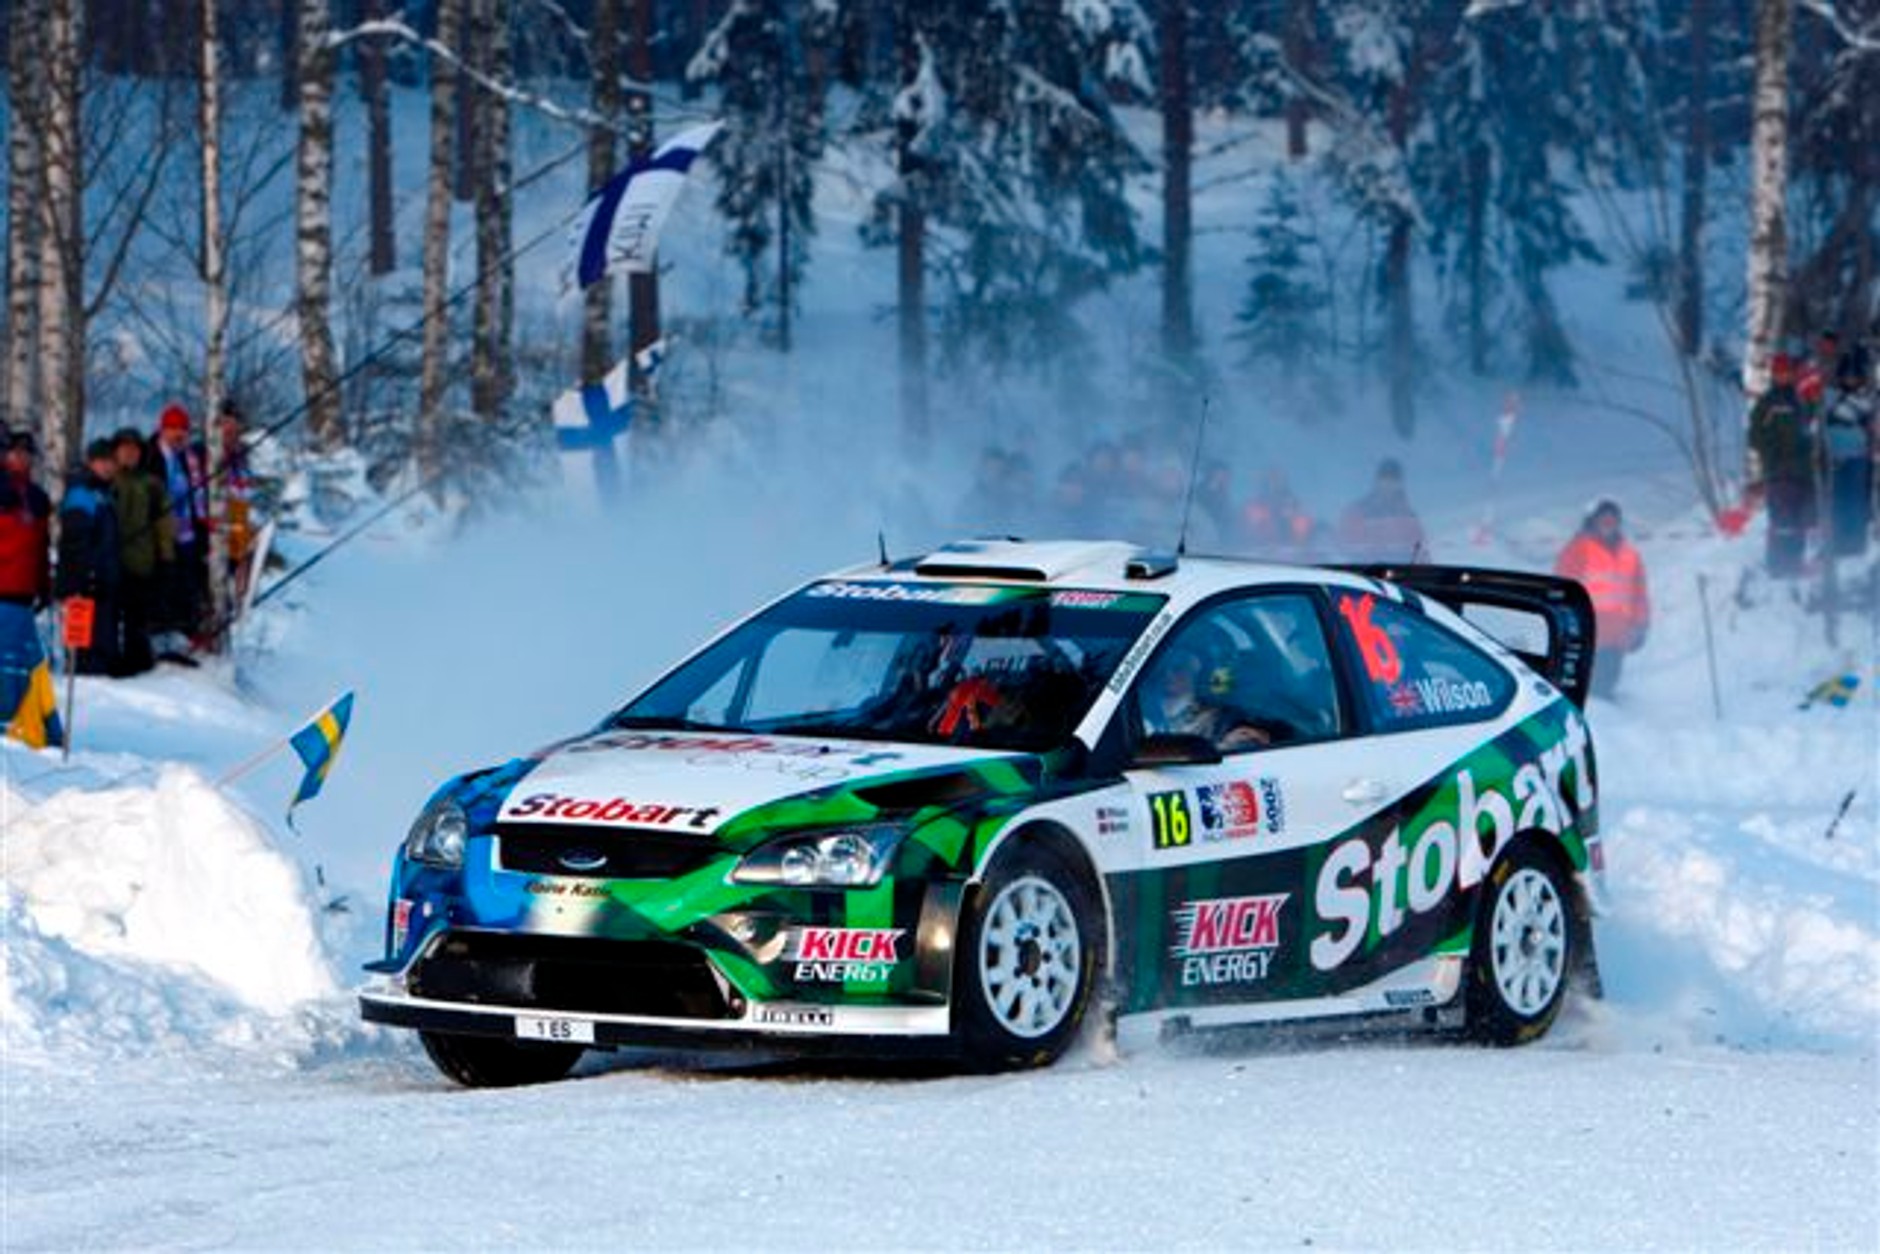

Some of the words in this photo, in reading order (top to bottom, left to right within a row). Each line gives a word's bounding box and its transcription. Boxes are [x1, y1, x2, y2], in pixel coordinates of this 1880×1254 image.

[1340, 592, 1400, 683] 16
[1416, 678, 1492, 714] Wilson
[508, 793, 719, 828] Stobart
[1154, 793, 1189, 847] 16
[1309, 710, 1594, 971] Stobart
[1187, 895, 1281, 951] KICK
[802, 929, 896, 961] KICK
[793, 962, 893, 982] ENERGY
[1181, 952, 1273, 986] ENERGY
